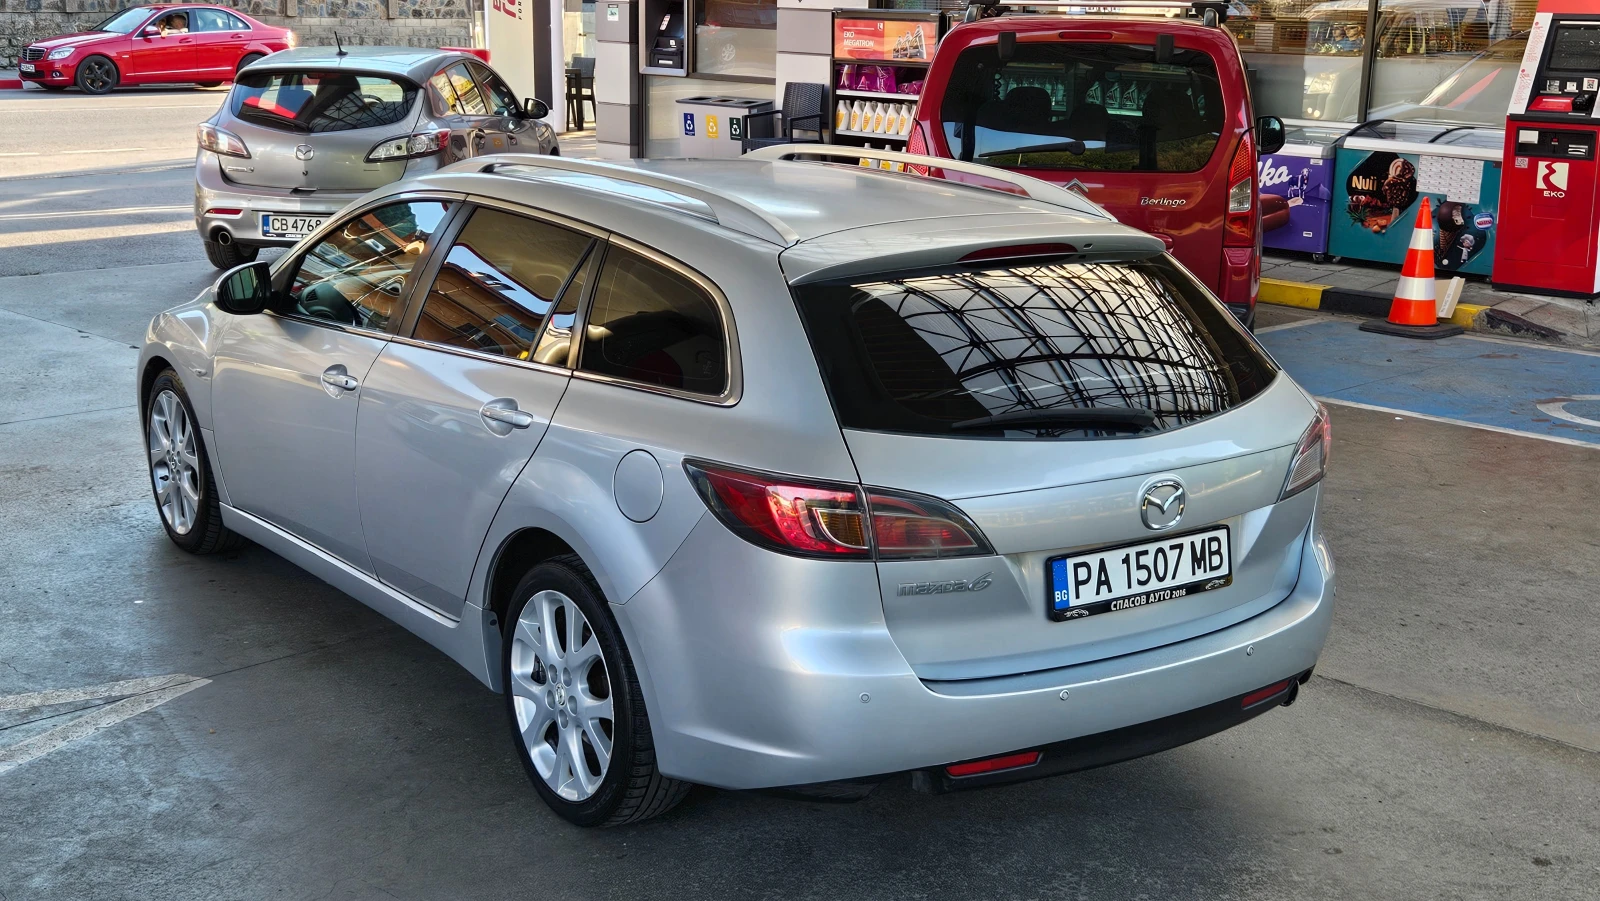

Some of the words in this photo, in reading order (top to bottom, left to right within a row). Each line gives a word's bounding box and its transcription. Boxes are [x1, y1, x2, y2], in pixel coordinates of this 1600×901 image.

[844, 39, 875, 48] MEGATRON
[1543, 190, 1566, 198] EKO
[1140, 196, 1186, 208] Berlingo
[271, 218, 289, 232] CB
[1073, 557, 1113, 600] PA
[1121, 543, 1184, 590] 1507
[1190, 536, 1224, 576] MB
[1055, 589, 1068, 602] BG
[1110, 595, 1147, 611] СПАСОВ
[1149, 590, 1171, 604] АУТО
[1171, 588, 1187, 599] 2016
